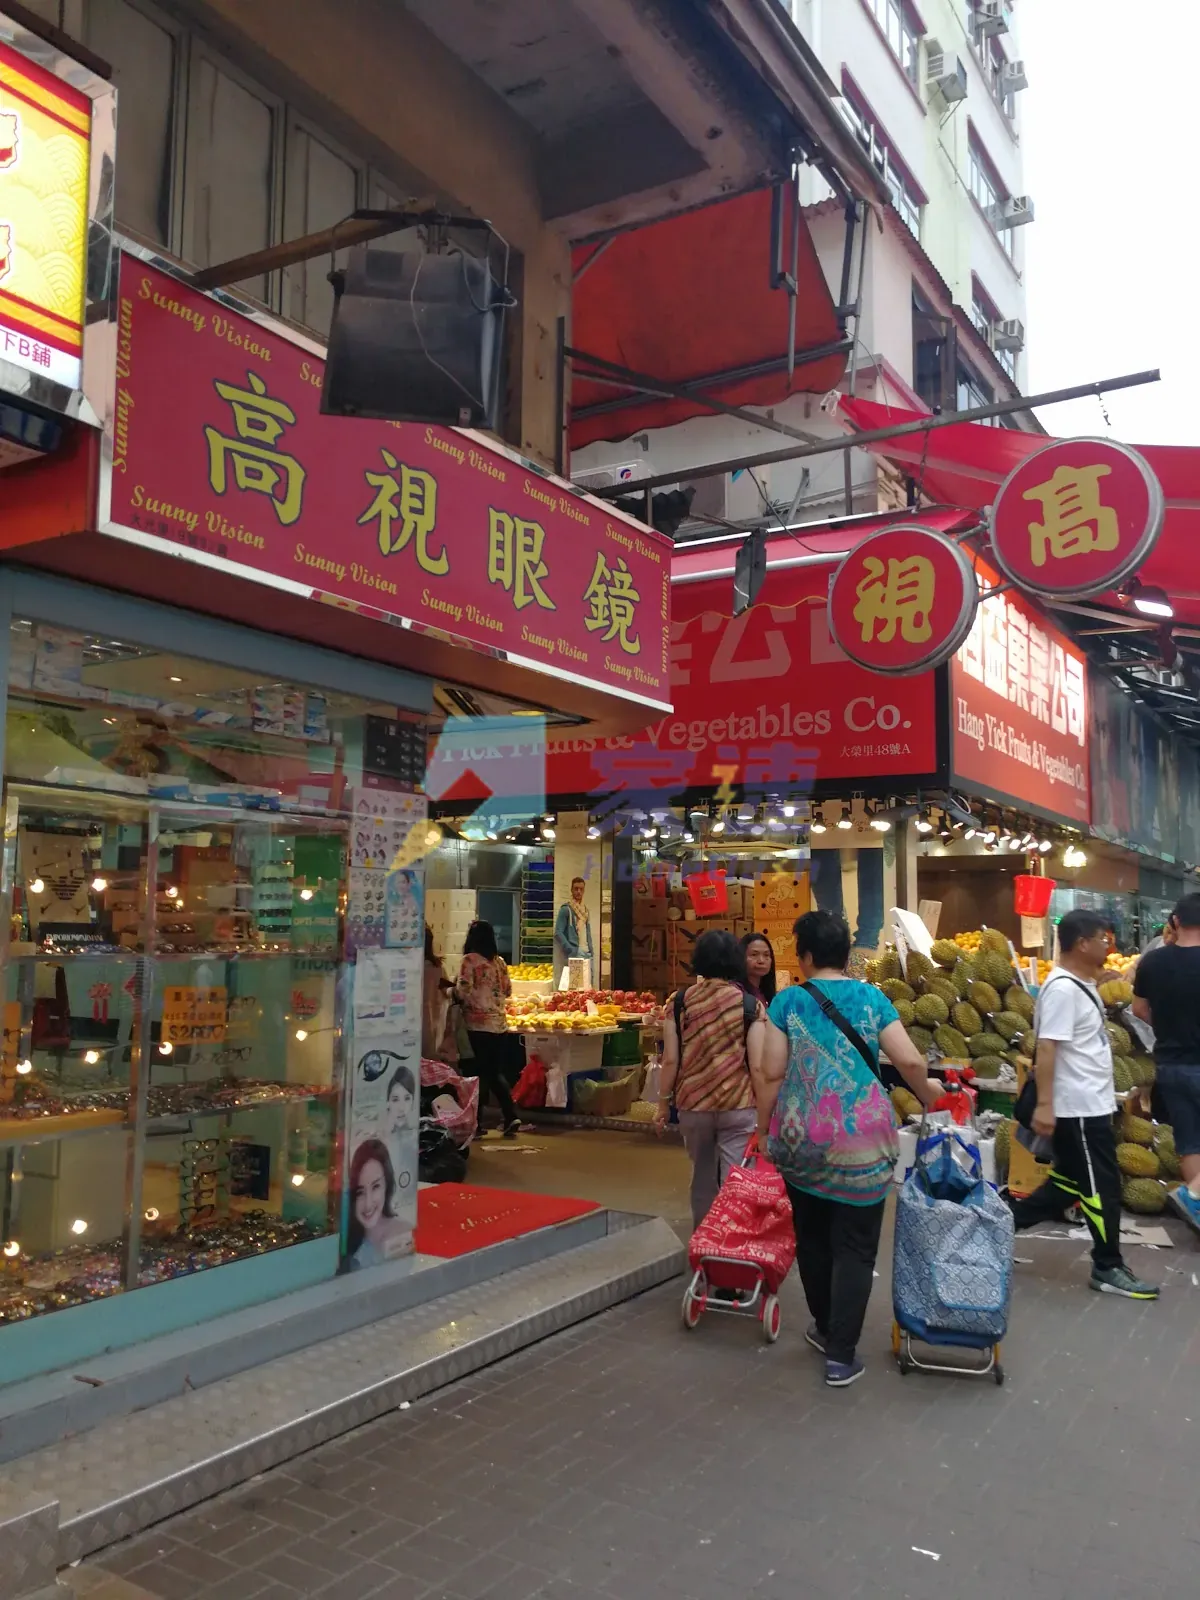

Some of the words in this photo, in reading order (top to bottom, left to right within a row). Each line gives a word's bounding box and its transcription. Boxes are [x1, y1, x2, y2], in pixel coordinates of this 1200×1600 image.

[138, 277, 206, 332] Sunny
[212, 314, 272, 362] Vision
[112, 388, 135, 473] Sunny
[424, 427, 466, 465] Sunny
[468, 449, 506, 483] Vision
[130, 485, 200, 532] Sunny
[205, 510, 265, 549] Vision
[203, 369, 641, 656] 高視眼鏡
[523, 479, 557, 511] Sunny
[559, 497, 590, 526] Vision
[293, 543, 348, 582] Sunny
[350, 562, 398, 595] Vision
[606, 522, 633, 553] Sunny
[635, 538, 661, 564] Vision
[420, 588, 463, 622] Sunny
[465, 604, 504, 632] Vision
[661, 570, 670, 620] Sunny
[853, 555, 935, 643] 視
[521, 625, 555, 655] Sunny
[557, 638, 588, 662] Vision
[604, 655, 633, 681] Sunny
[634, 665, 660, 688] Vision
[645, 702, 831, 752] Vegetables
[842, 696, 912, 732] Co.
[957, 697, 985, 751] Hang
[985, 713, 1008, 755] Yick
[1007, 725, 1031, 766] Fruits
[1032, 740, 1040, 770] &
